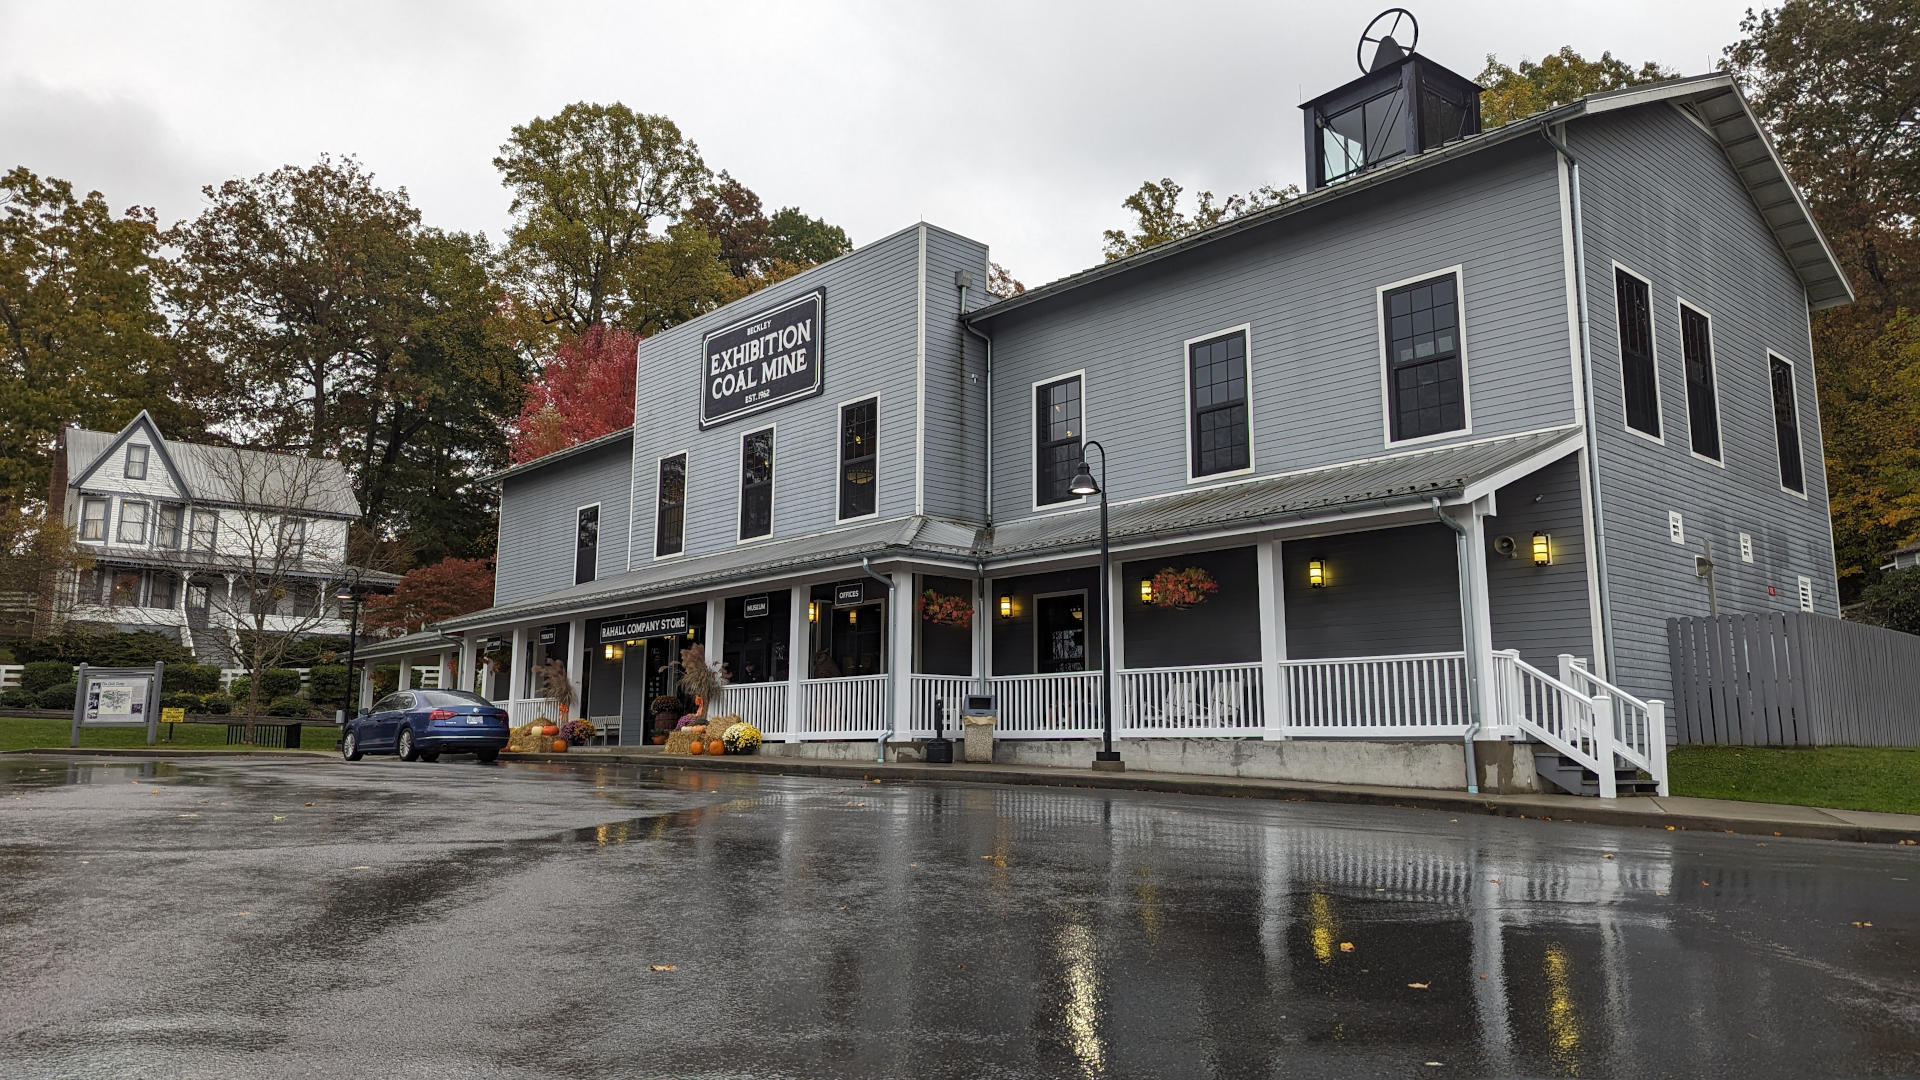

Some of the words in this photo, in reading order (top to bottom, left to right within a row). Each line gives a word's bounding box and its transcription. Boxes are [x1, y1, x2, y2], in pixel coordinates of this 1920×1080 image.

[747, 320, 771, 335] BECKLEY
[711, 319, 811, 376] EXHIBITION
[712, 367, 757, 399] COAL
[761, 348, 807, 384] MINE
[744, 394, 758, 404] EST.
[758, 389, 770, 400] 1962
[839, 590, 858, 599] OFFICES
[747, 603, 765, 611] MUSEUM
[601, 625, 626, 638] RAHALL
[626, 619, 661, 635] COMPANY
[660, 616, 686, 630] STORE
